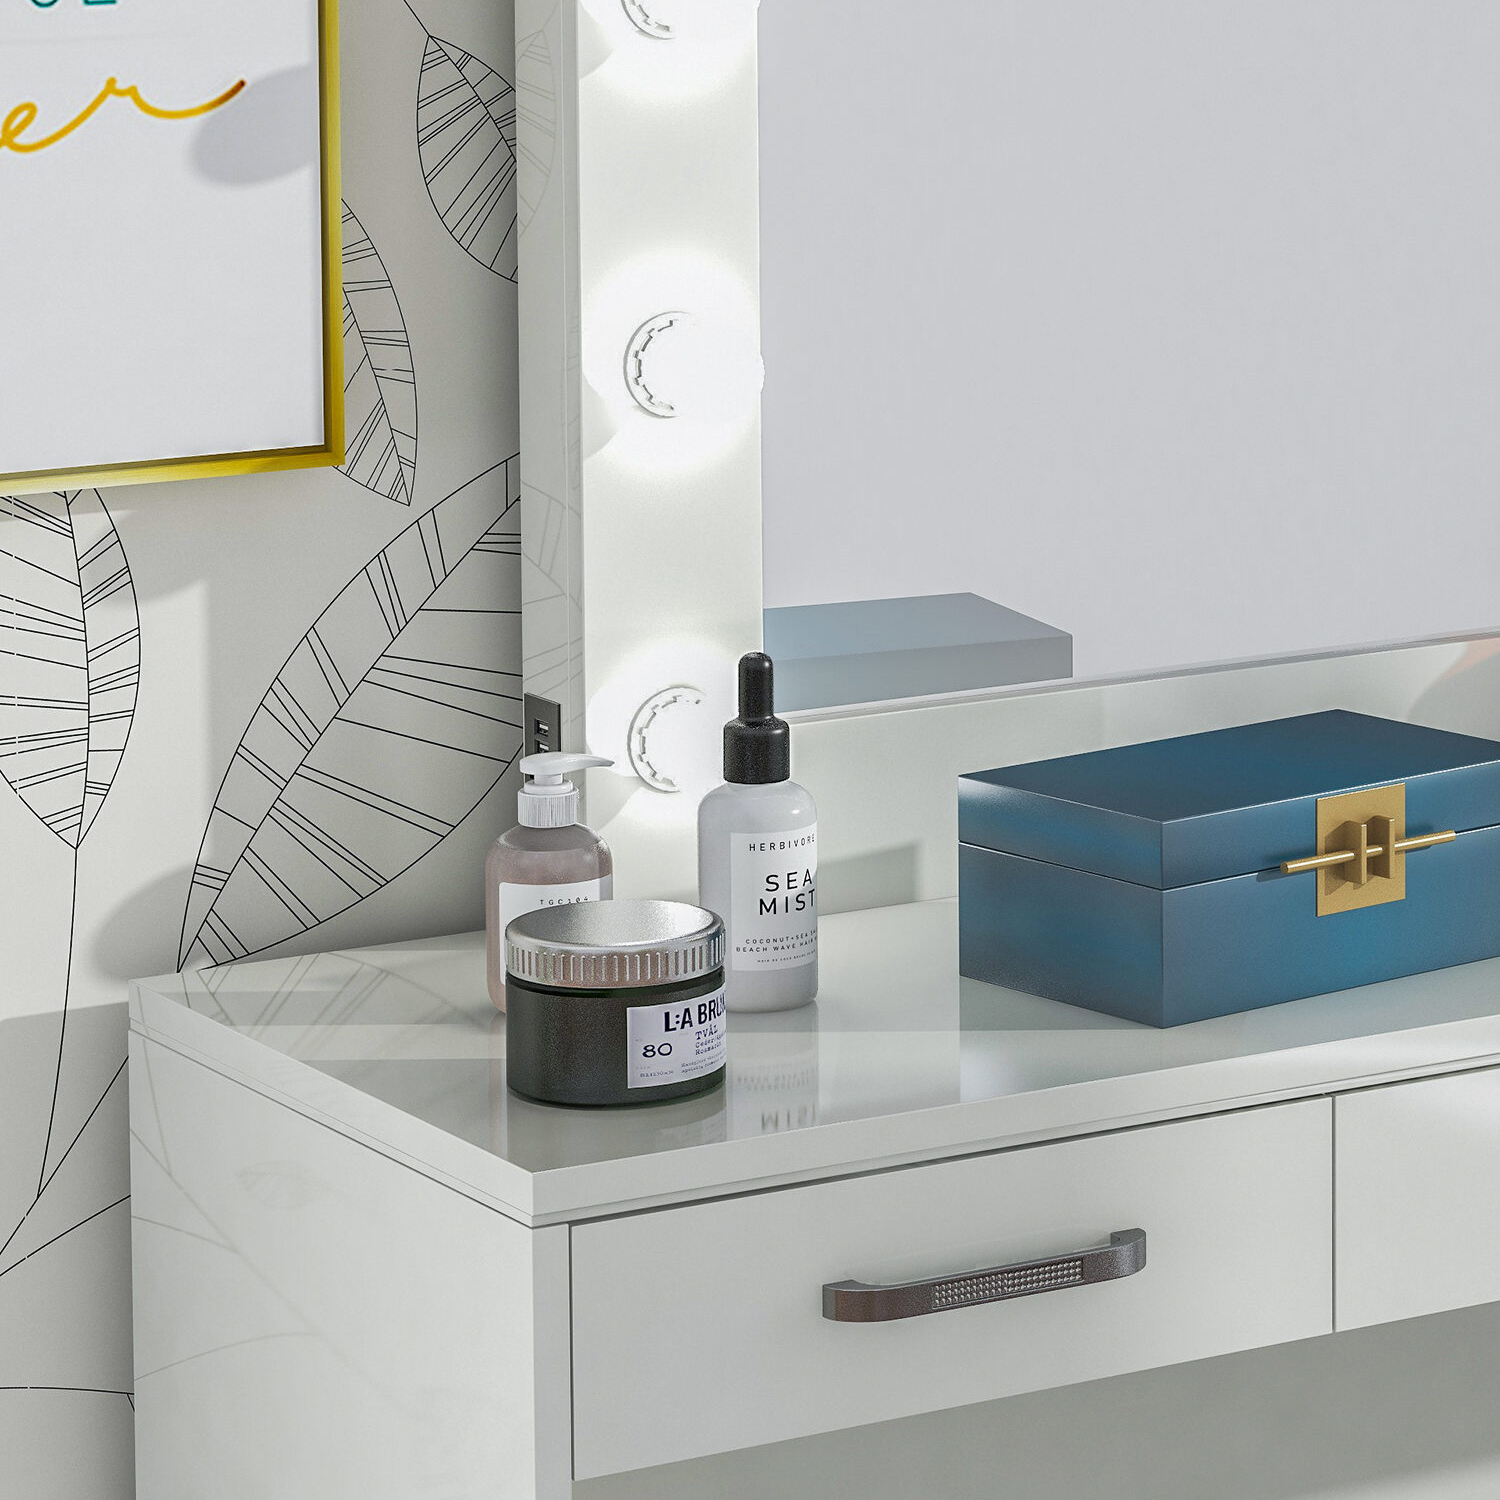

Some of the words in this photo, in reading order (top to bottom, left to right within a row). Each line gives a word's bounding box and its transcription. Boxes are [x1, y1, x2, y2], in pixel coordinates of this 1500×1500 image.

[749, 833, 815, 852] HERBIVORE
[765, 868, 812, 893] SEA
[759, 888, 816, 916] MIST
[642, 1042, 673, 1059] 80
